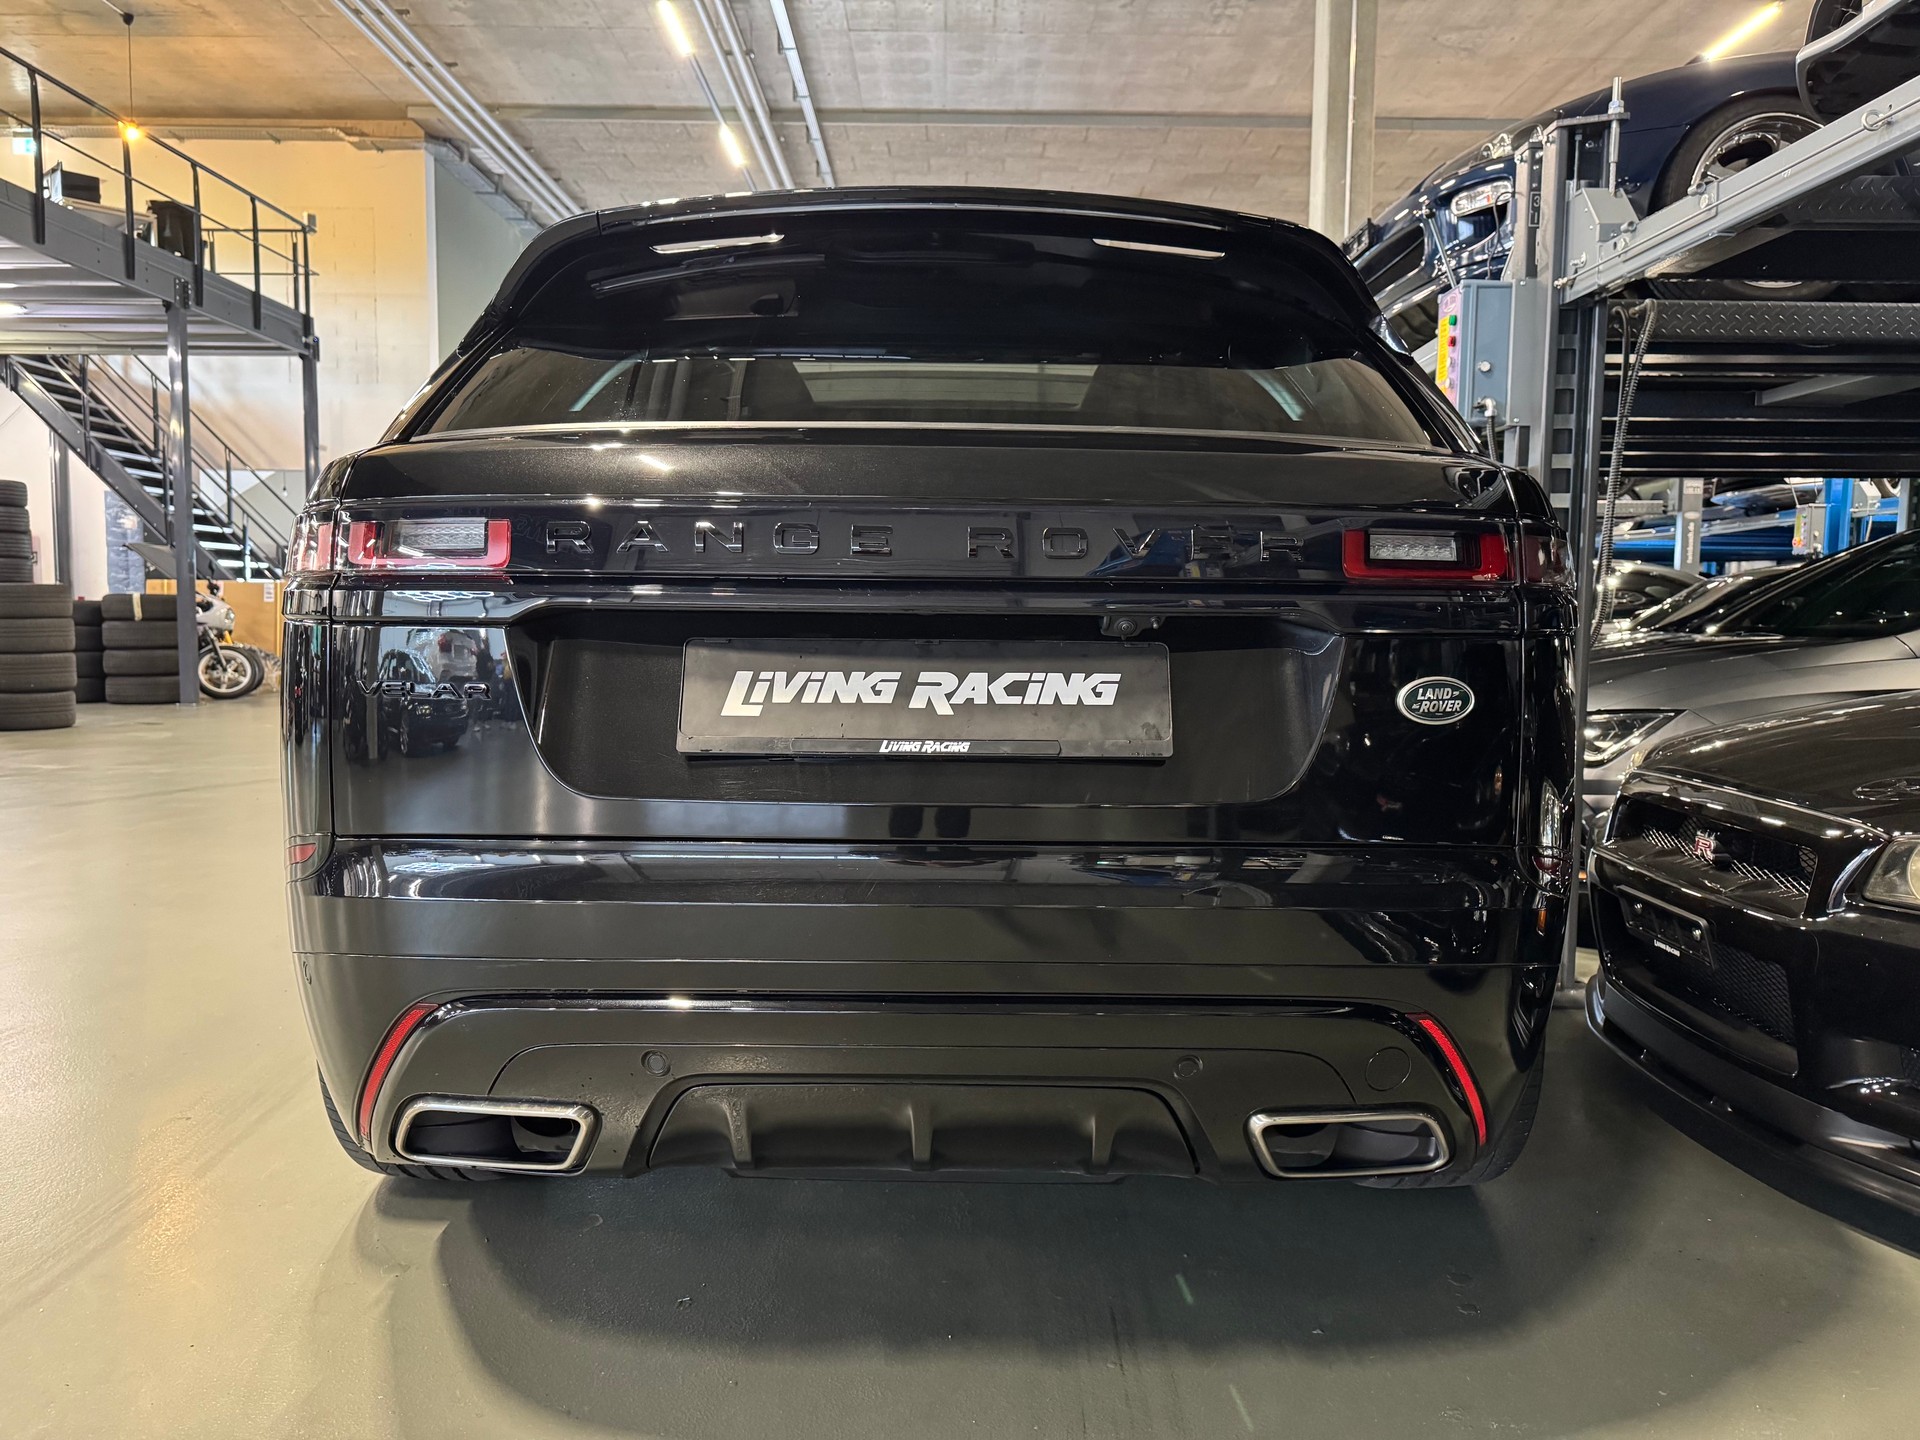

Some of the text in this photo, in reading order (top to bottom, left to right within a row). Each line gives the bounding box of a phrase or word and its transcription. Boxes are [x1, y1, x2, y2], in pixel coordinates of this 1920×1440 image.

[546, 520, 1304, 562] RANGE ROVER
[356, 680, 492, 699] VELAR
[1417, 688, 1452, 700] LAND
[1420, 700, 1462, 712] ROVER
